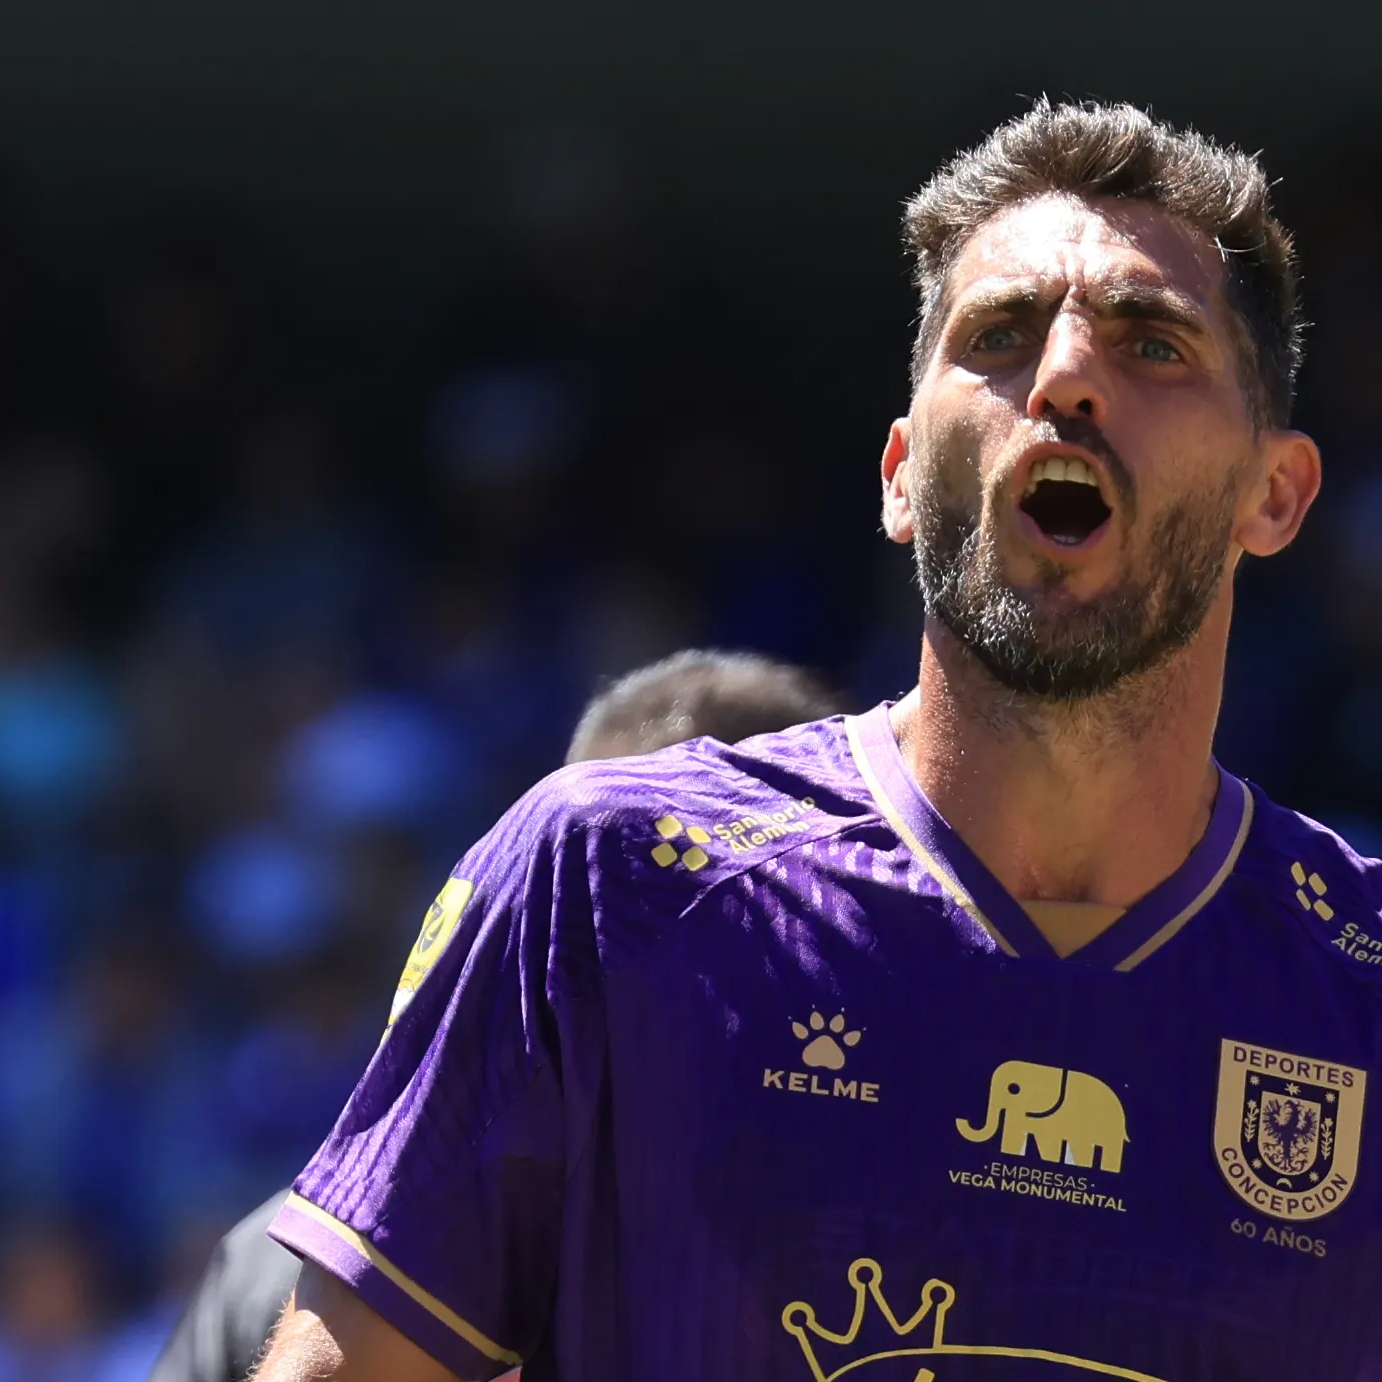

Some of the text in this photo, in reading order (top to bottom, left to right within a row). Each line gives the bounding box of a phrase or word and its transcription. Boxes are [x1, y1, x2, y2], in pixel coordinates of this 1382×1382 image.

[762, 1068, 880, 1103] KELME
[1232, 1046, 1355, 1088] DEPORTES
[948, 1169, 1127, 1213] VEGA MONUMENTAL
[990, 1161, 1088, 1190] EMPRESAS
[1221, 1147, 1349, 1214] CONCEPCION
[1230, 1218, 1327, 1257] 60 AÑOS
